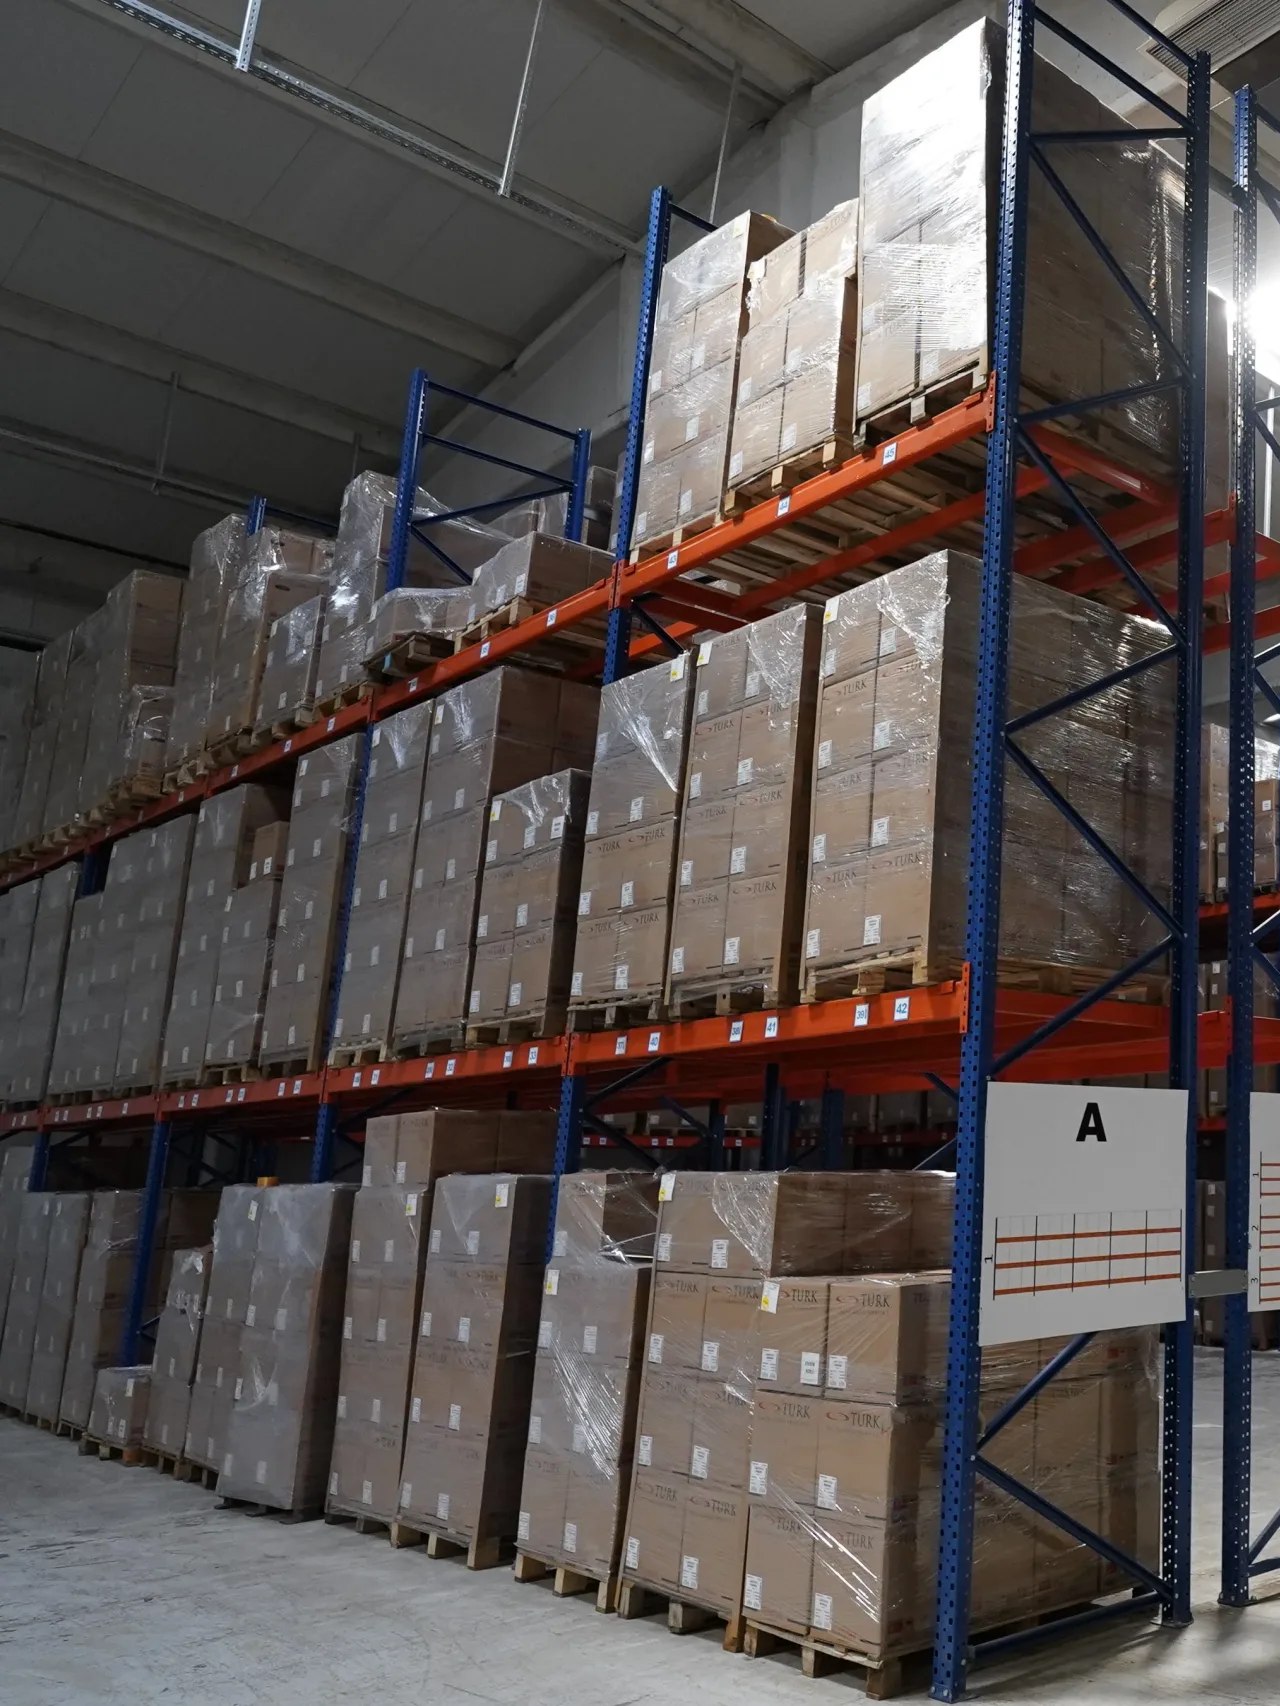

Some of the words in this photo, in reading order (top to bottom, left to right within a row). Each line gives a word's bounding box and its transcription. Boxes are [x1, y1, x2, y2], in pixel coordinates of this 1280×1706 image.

[896, 1003, 908, 1014] 42
[767, 1022, 776, 1032] 41
[1075, 1102, 1107, 1142] A
[791, 1288, 819, 1304] TURK
[860, 1293, 890, 1309] TURK
[781, 1402, 810, 1419] TURK
[850, 1411, 881, 1429] TURK
